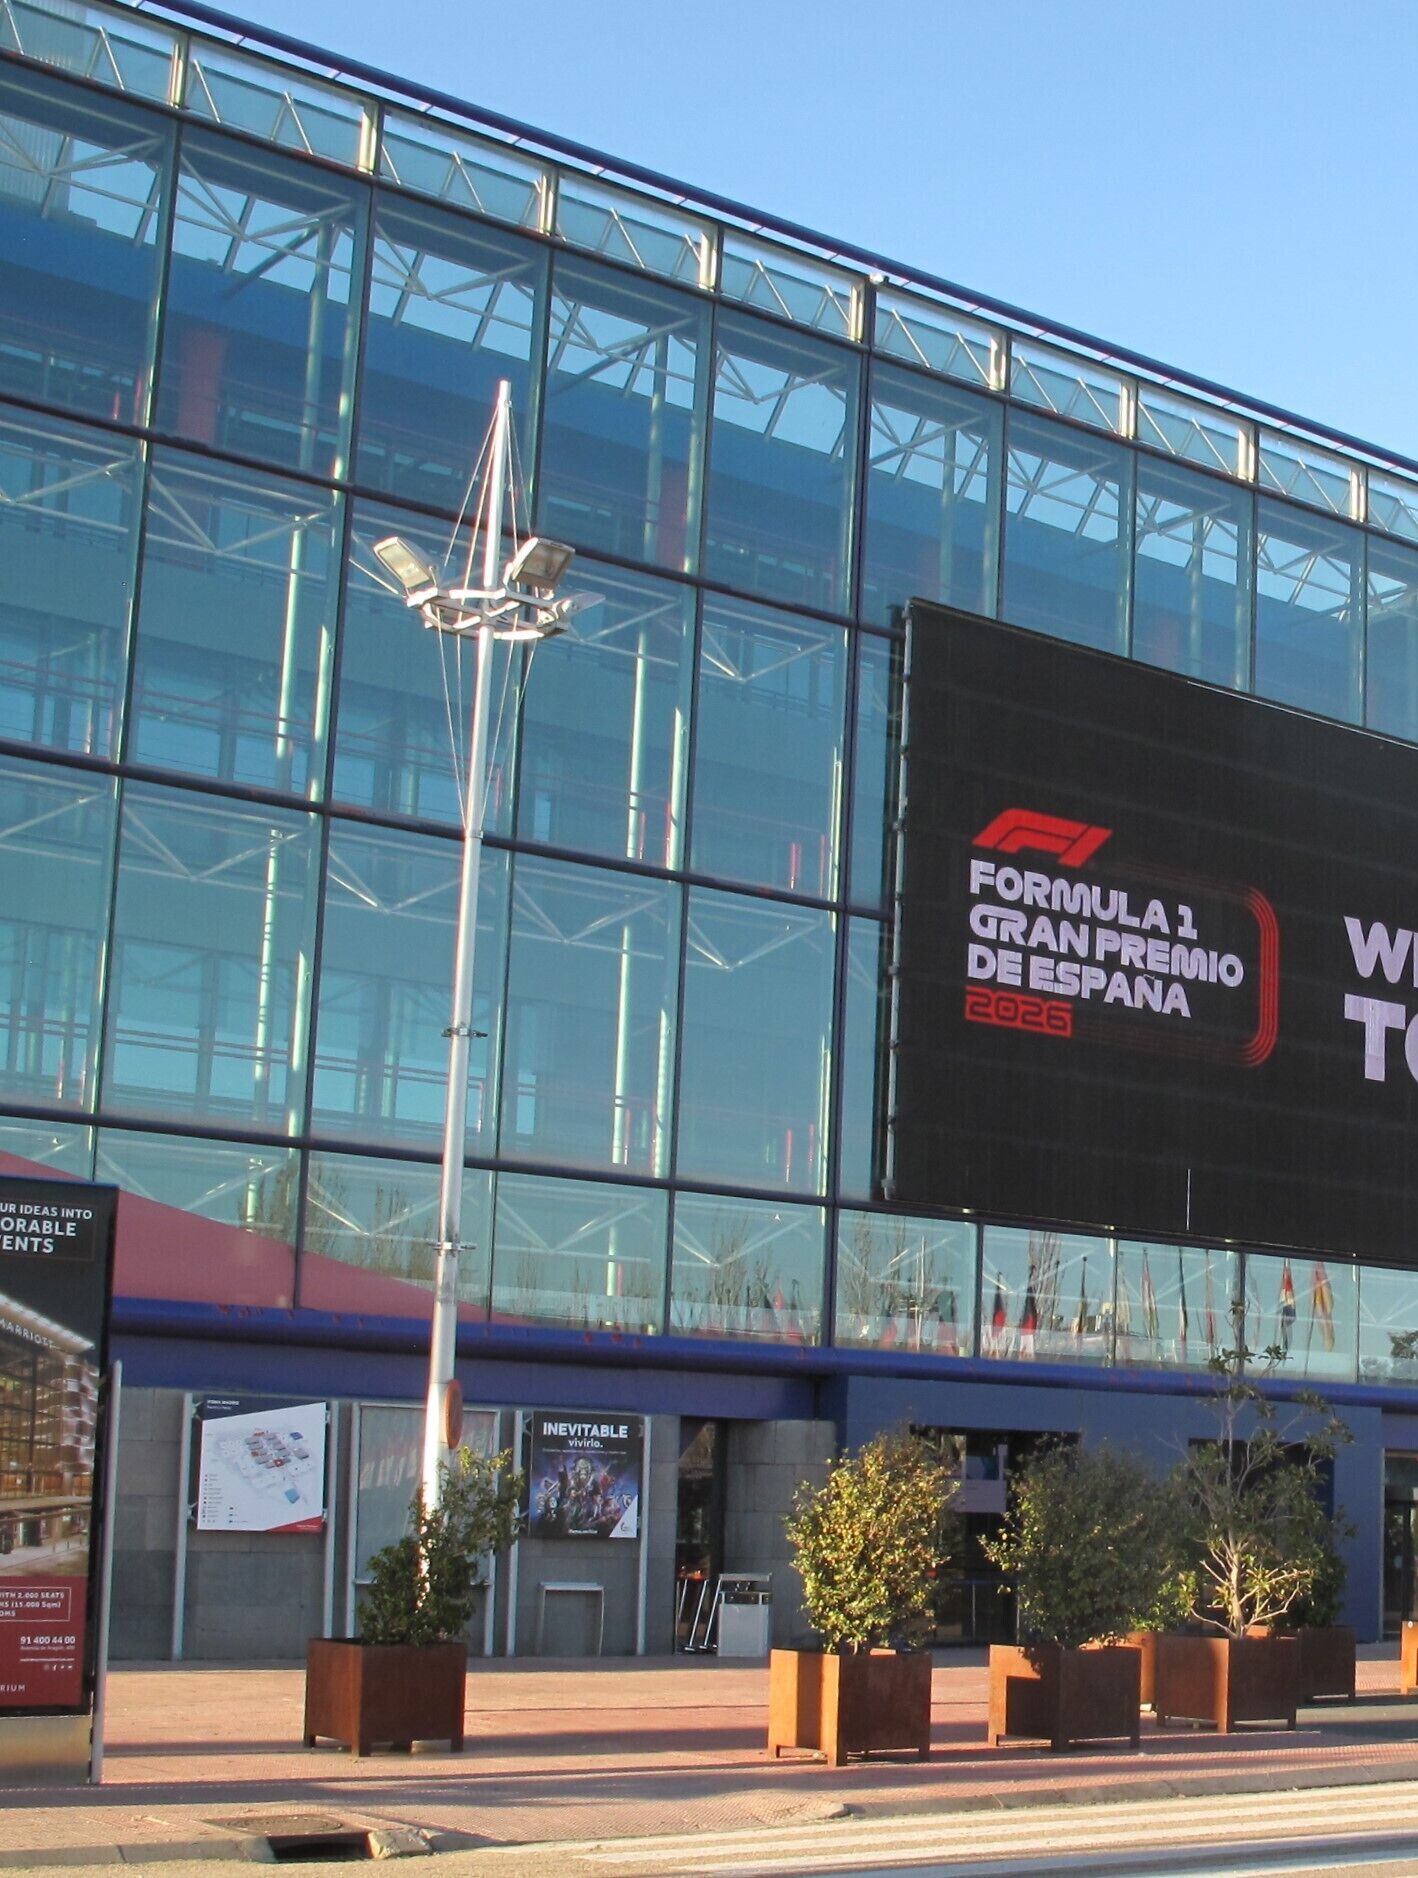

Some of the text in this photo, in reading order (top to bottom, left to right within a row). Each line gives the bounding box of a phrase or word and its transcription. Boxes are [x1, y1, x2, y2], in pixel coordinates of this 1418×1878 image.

[969, 859, 1198, 940] FORMULA 1
[969, 904, 1244, 987] GRAN PREMIO
[967, 943, 1192, 1018] DE ESPAÑA
[966, 987, 1071, 1036] 2026
[20, 1204, 58, 1216] IDEAS
[61, 1207, 93, 1219] INTO
[1, 1216, 76, 1236] ORABLE
[0, 1235, 54, 1253] ENTS
[543, 1422, 628, 1438] INEVITABLE
[20, 1636, 76, 1644] 91 400 44 00
